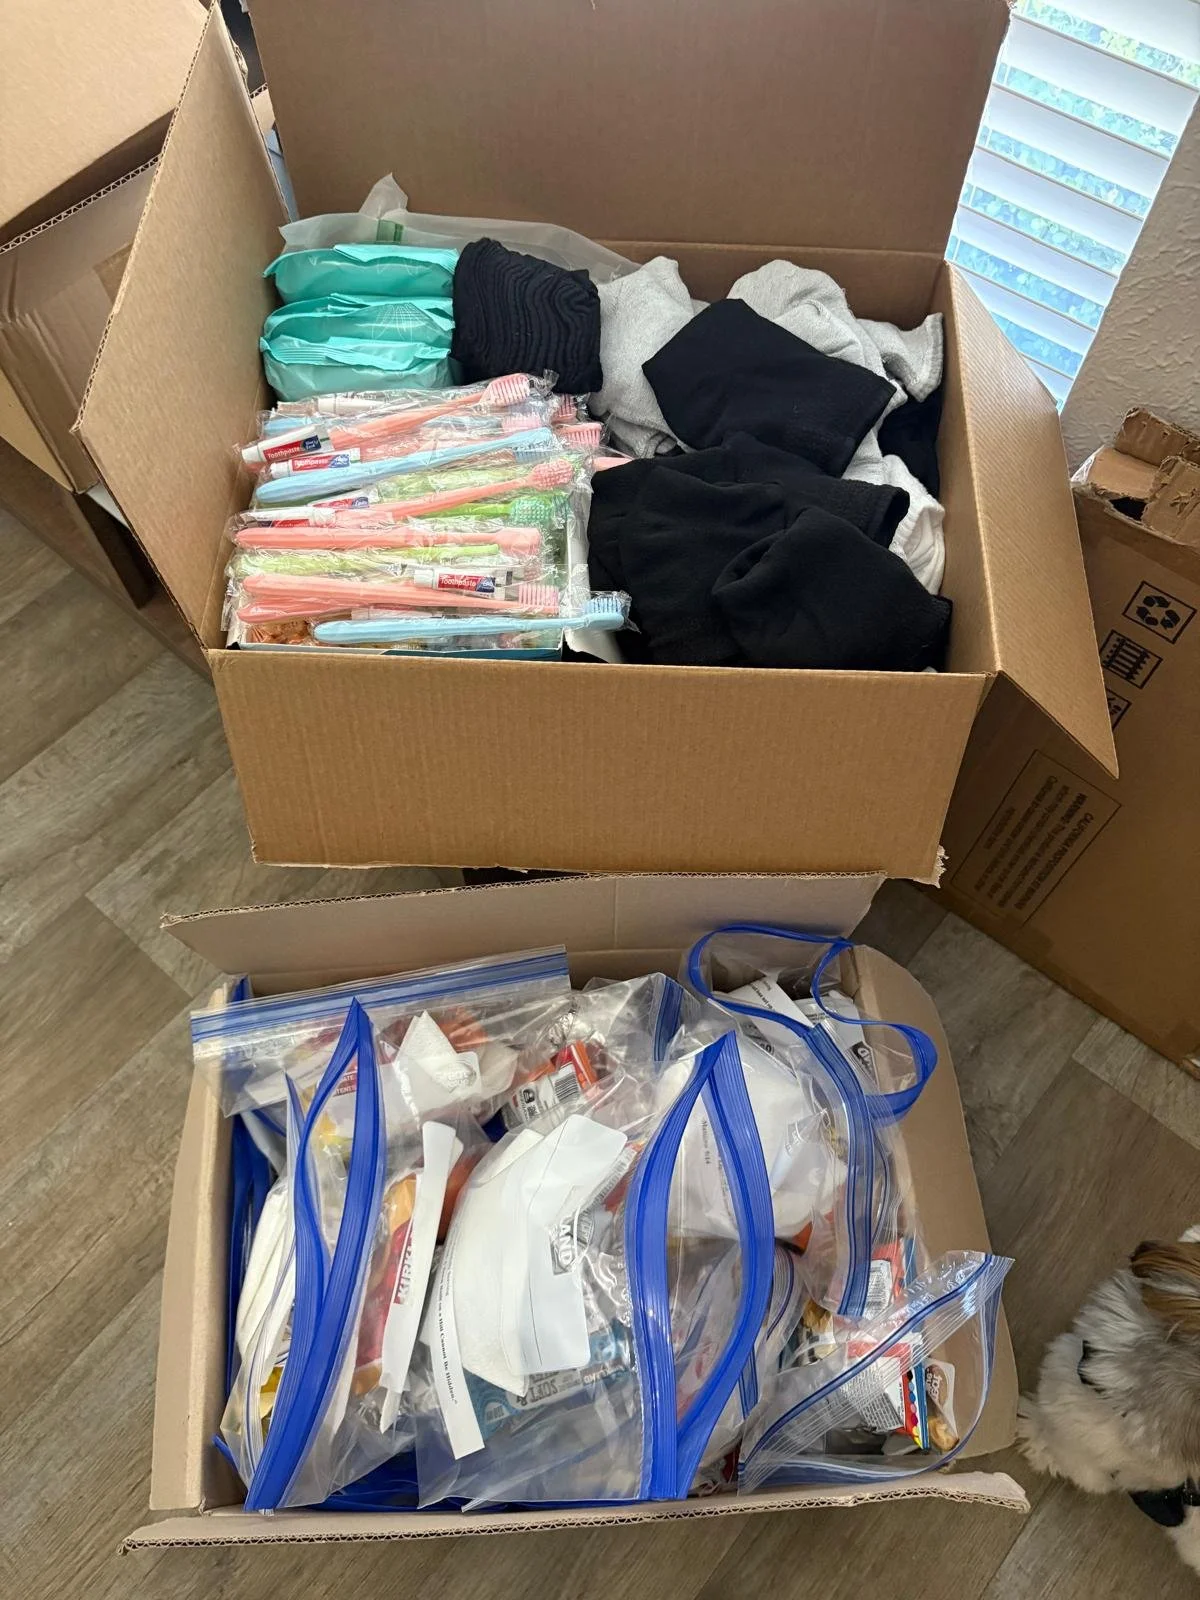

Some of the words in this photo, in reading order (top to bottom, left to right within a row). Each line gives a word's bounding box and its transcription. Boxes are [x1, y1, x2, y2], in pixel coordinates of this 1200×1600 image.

[266, 445, 301, 459] Toothpaste
[439, 575, 477, 587] Toothpaste
[439, 1332, 447, 1359] Cannot
[443, 1360, 449, 1371] Be
[527, 1378, 559, 1403] SOFT
